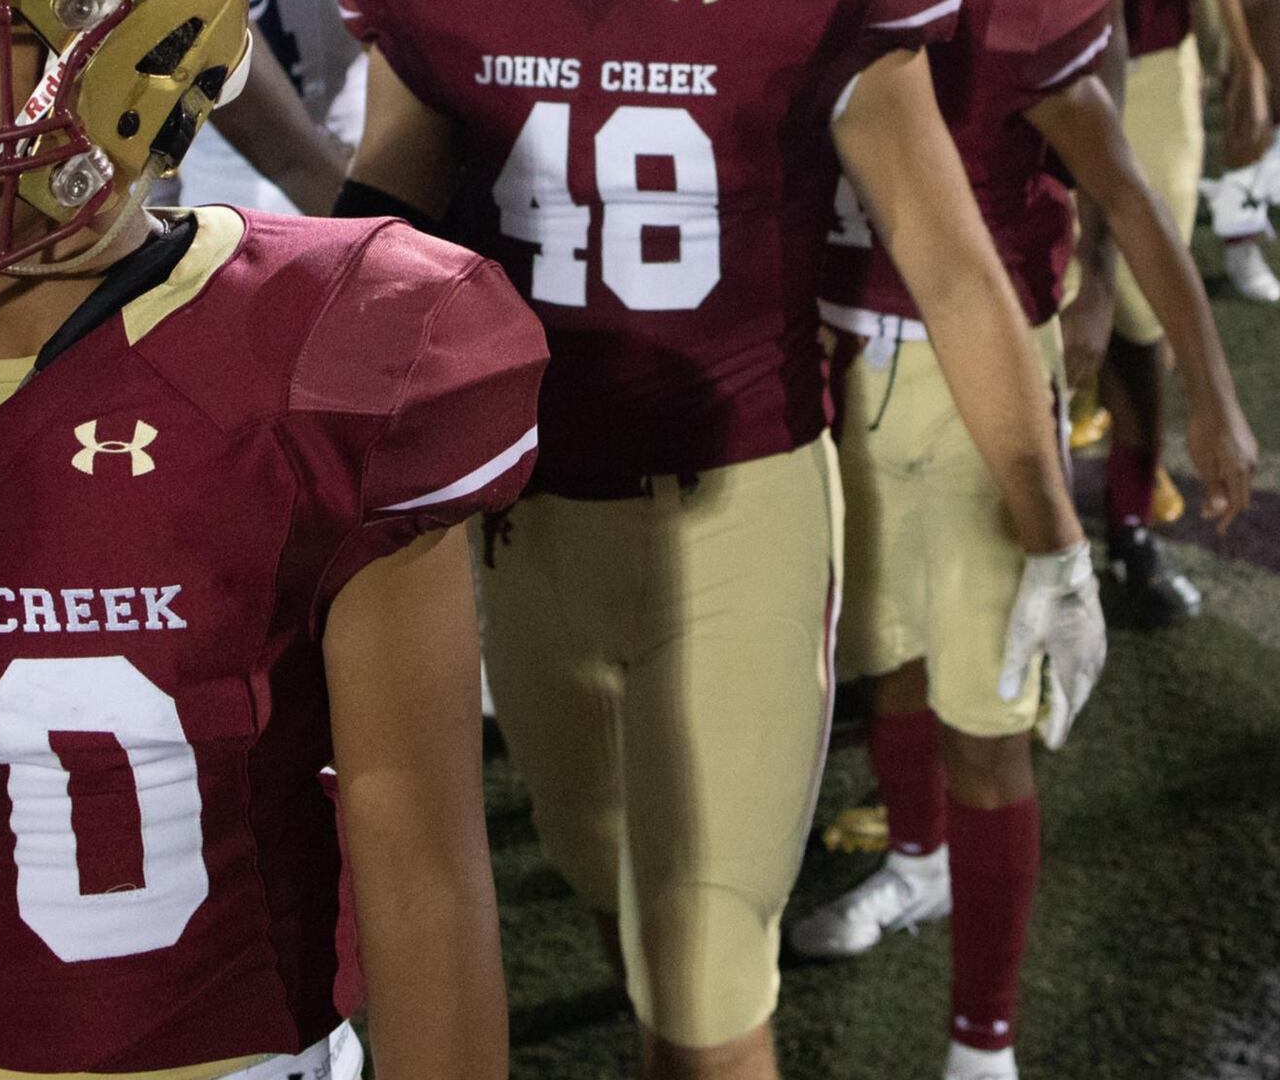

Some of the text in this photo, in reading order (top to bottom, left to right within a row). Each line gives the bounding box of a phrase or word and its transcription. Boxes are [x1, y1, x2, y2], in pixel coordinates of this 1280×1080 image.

[474, 54, 719, 95] JOHNS CREEK
[491, 100, 721, 311] 48
